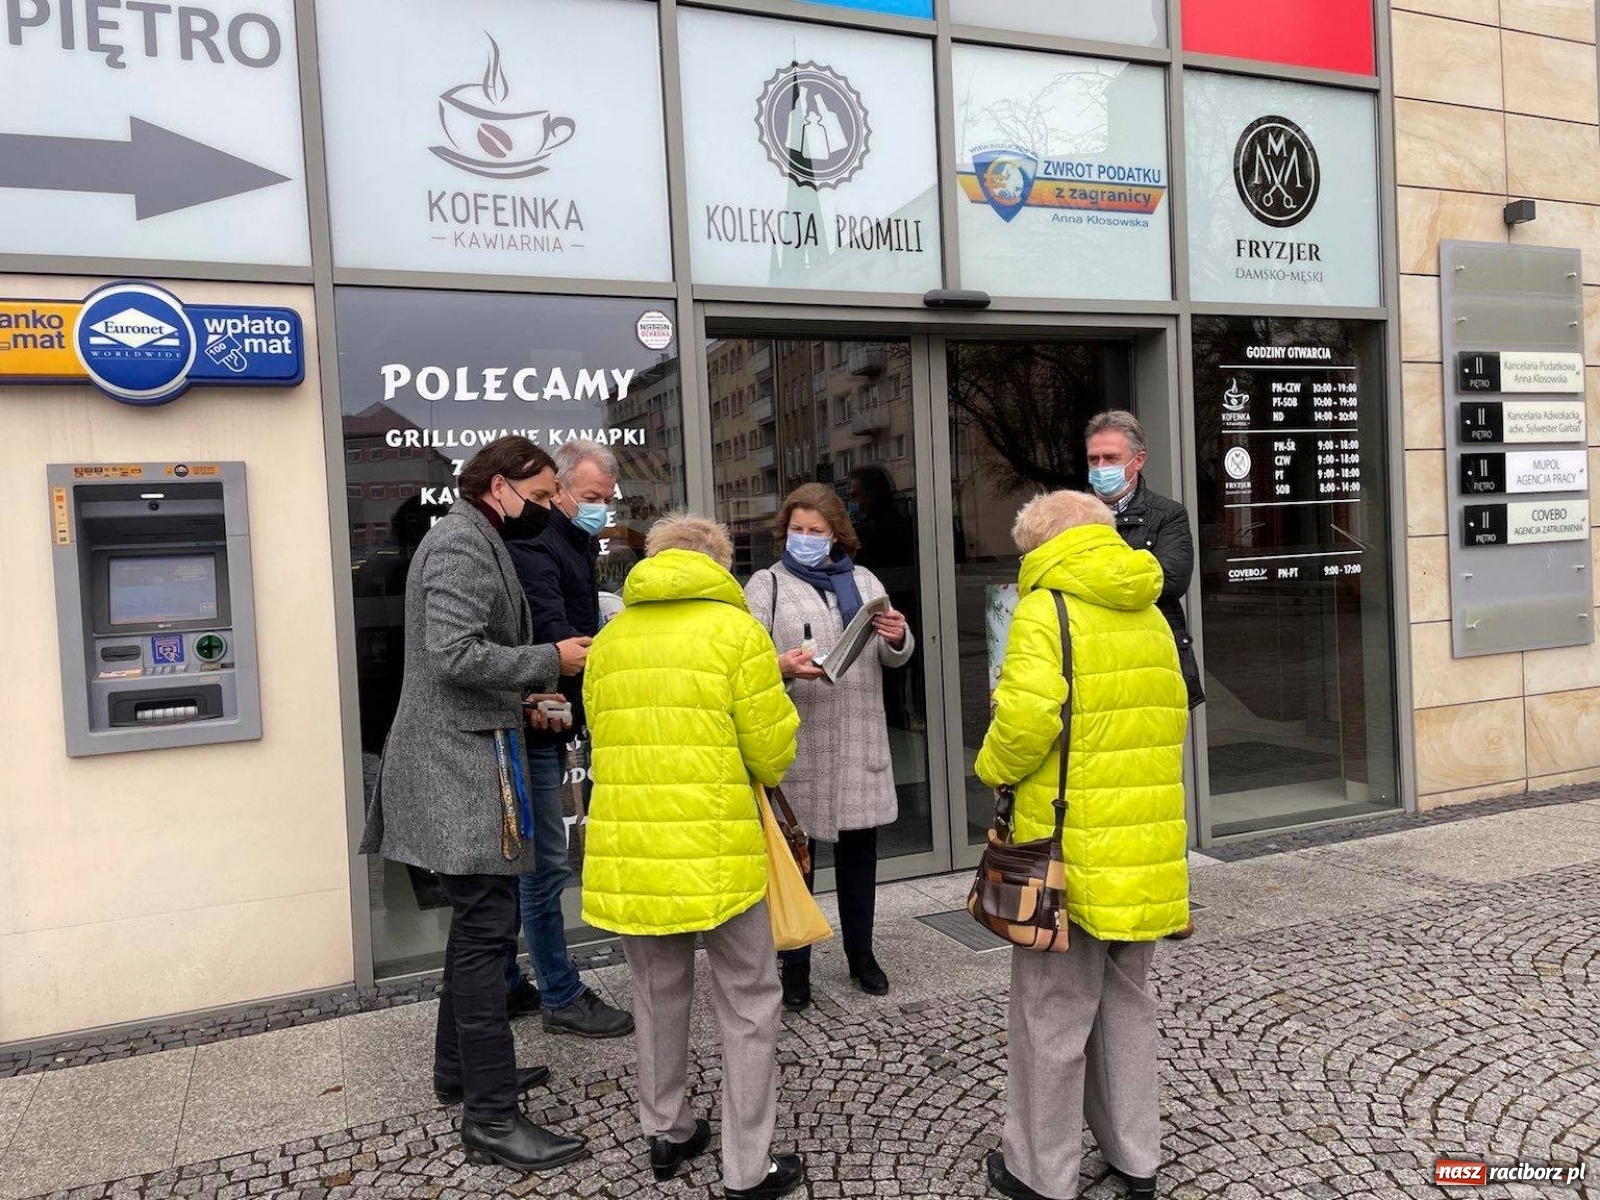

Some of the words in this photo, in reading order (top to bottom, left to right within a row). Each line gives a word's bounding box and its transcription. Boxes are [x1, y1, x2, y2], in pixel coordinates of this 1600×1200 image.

[6, 0, 281, 69] PIĘTRO
[1043, 160, 1094, 179] ZWROT
[1098, 164, 1161, 183] PODATKU
[1055, 187, 1065, 199] z
[1069, 187, 1152, 207] zagranicy
[427, 190, 584, 231] KOFEINKA
[1051, 212, 1083, 224] Anna
[1086, 215, 1149, 228] Kłosowska
[705, 204, 818, 249] KOLEKCJA
[835, 213, 924, 253] PROMILI
[454, 231, 564, 253] KAWIARNIA
[1236, 239, 1321, 264] FRYZJER
[1236, 267, 1324, 284] DAMSKO-MĘSKI
[103, 320, 165, 336] Euronet
[203, 314, 291, 337] wpłato
[11, 331, 66, 350] mat
[243, 336, 293, 354] mat
[91, 350, 182, 359] WORLDWIDE
[208, 341, 227, 356] 100
[1246, 345, 1286, 359] GODZINY
[1287, 346, 1332, 360] OTWARCIA
[1503, 361, 1538, 371] Kancelaria
[1539, 361, 1576, 371] Podatkowa
[380, 363, 636, 402] POLECAMY
[1469, 379, 1491, 389] PIĘTRO
[1513, 374, 1532, 383] Anna
[1533, 374, 1568, 384] Kłosowska
[1272, 383, 1301, 393] PN-CZW
[1272, 397, 1298, 407] PT-SOB
[1272, 411, 1285, 422] ND
[1507, 411, 1542, 421] Kancelaria
[1543, 411, 1580, 421] Adwokacka
[1471, 430, 1493, 440] PIĘTRO
[1508, 424, 1525, 433] adw.
[1526, 423, 1557, 435] Sylwester
[549, 428, 646, 446] KANAPKI
[1274, 438, 1296, 451] PN-ŚR
[1317, 440, 1334, 450] 9:00
[1340, 440, 1359, 450] 18:00
[1274, 455, 1291, 466] CZW
[1532, 459, 1561, 470] MUPOL
[1275, 469, 1284, 481] PT
[1516, 474, 1551, 486] AGENCJA
[1552, 472, 1577, 484] PRACY
[1275, 484, 1291, 495] SOB
[1473, 481, 1495, 491] PIĘTRO
[1531, 508, 1568, 521] COVEBO
[1513, 526, 1541, 536] AGENCJA
[1542, 523, 1583, 534] ZATRUDNIENIA
[1475, 533, 1497, 543] PIĘTRO
[1228, 568, 1260, 579] COVEBO
[1277, 567, 1299, 578] PN-PT
[1323, 566, 1339, 576] 9:00
[1343, 564, 1361, 574] 17:00
